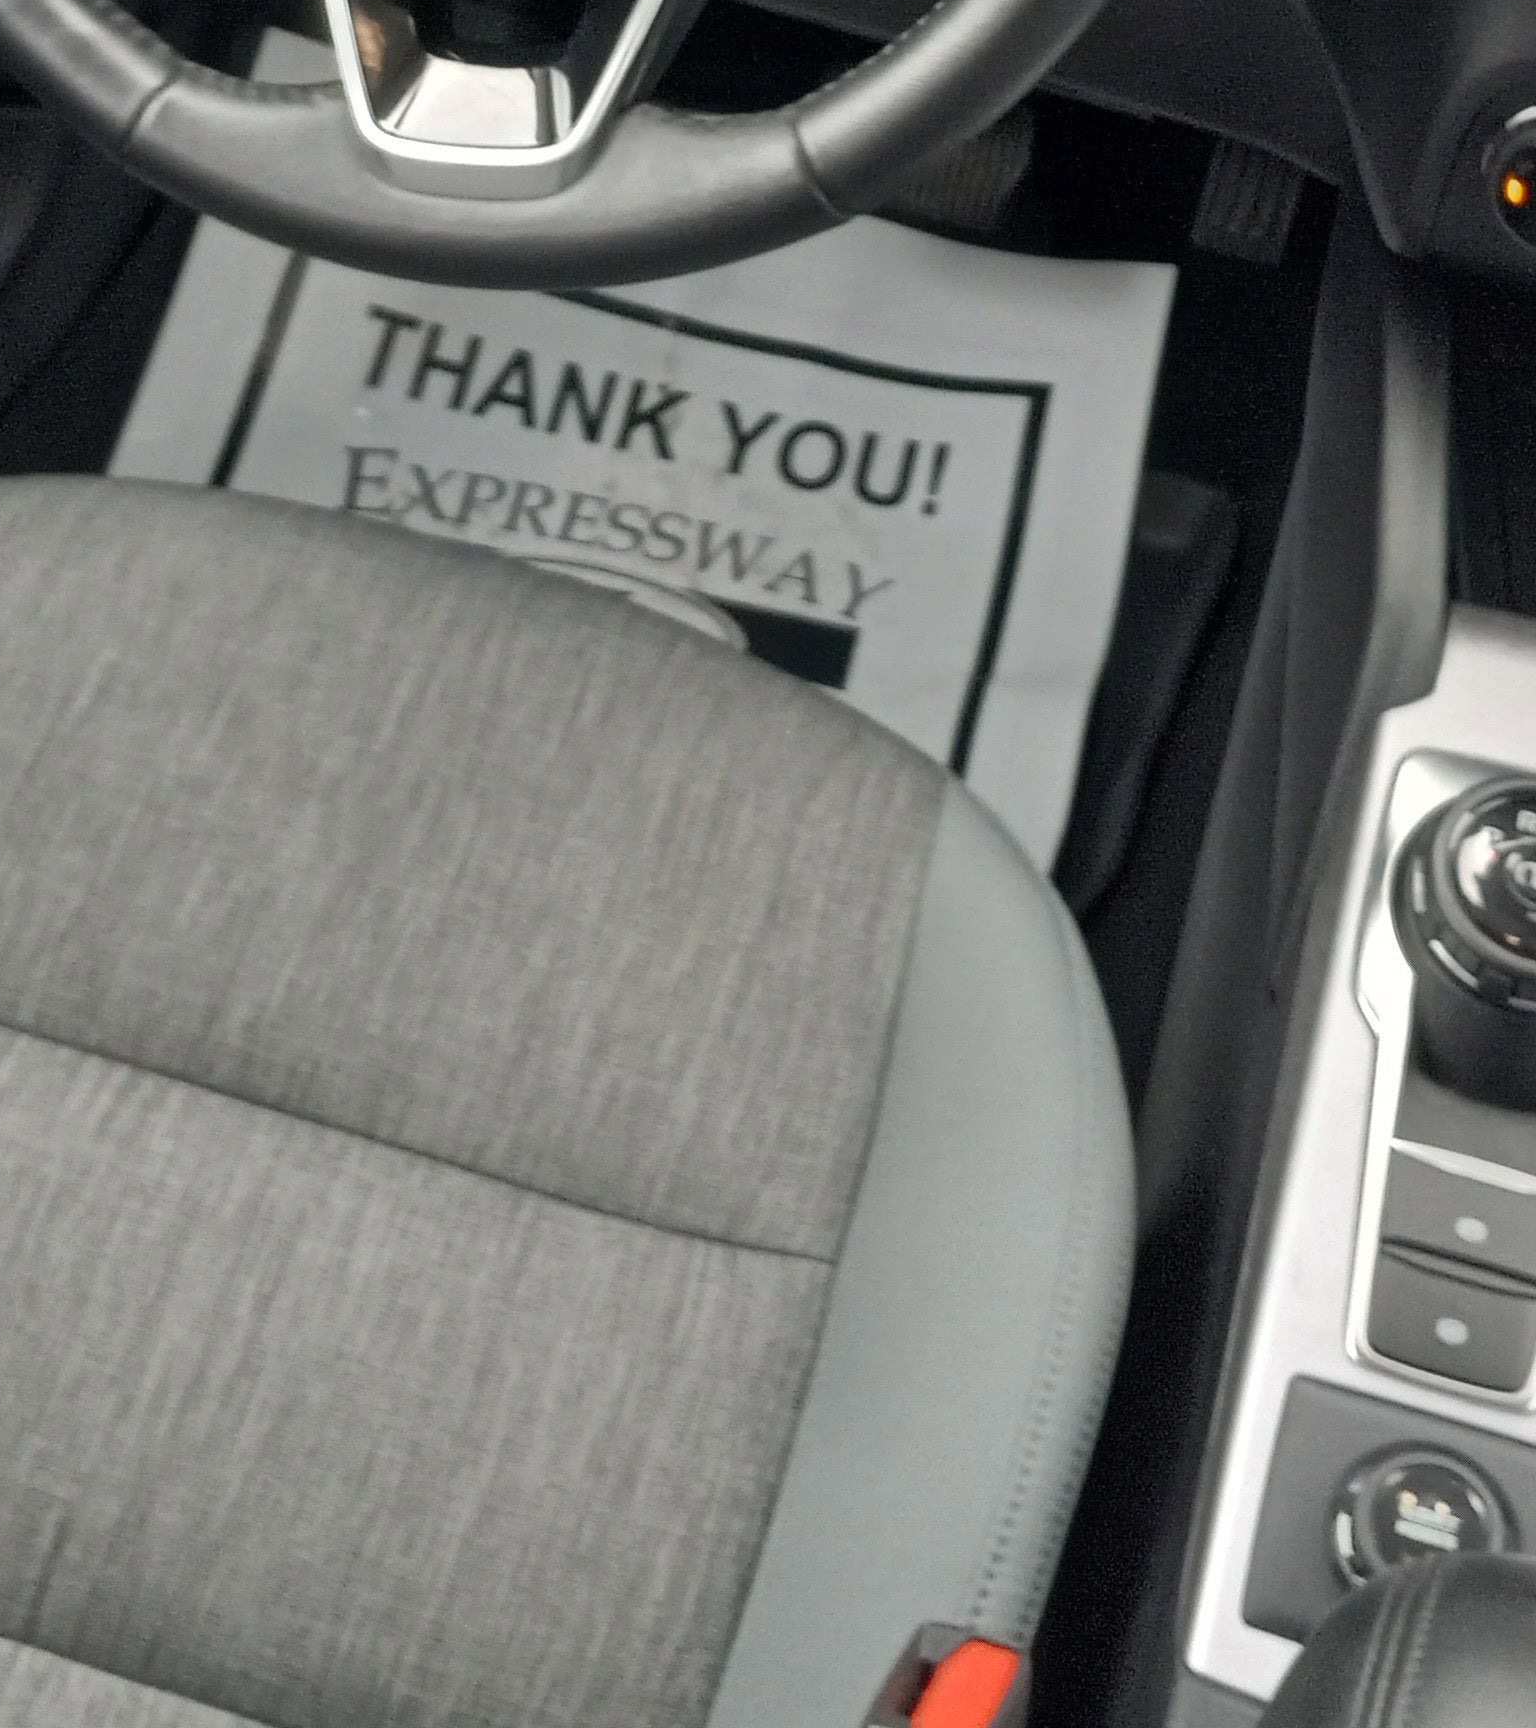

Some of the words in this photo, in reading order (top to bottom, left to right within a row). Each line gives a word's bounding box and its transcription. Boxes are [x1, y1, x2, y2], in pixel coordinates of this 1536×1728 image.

[366, 303, 691, 462] THANK
[720, 398, 953, 518] YOU!
[342, 444, 895, 622] EXPRESSWAY
